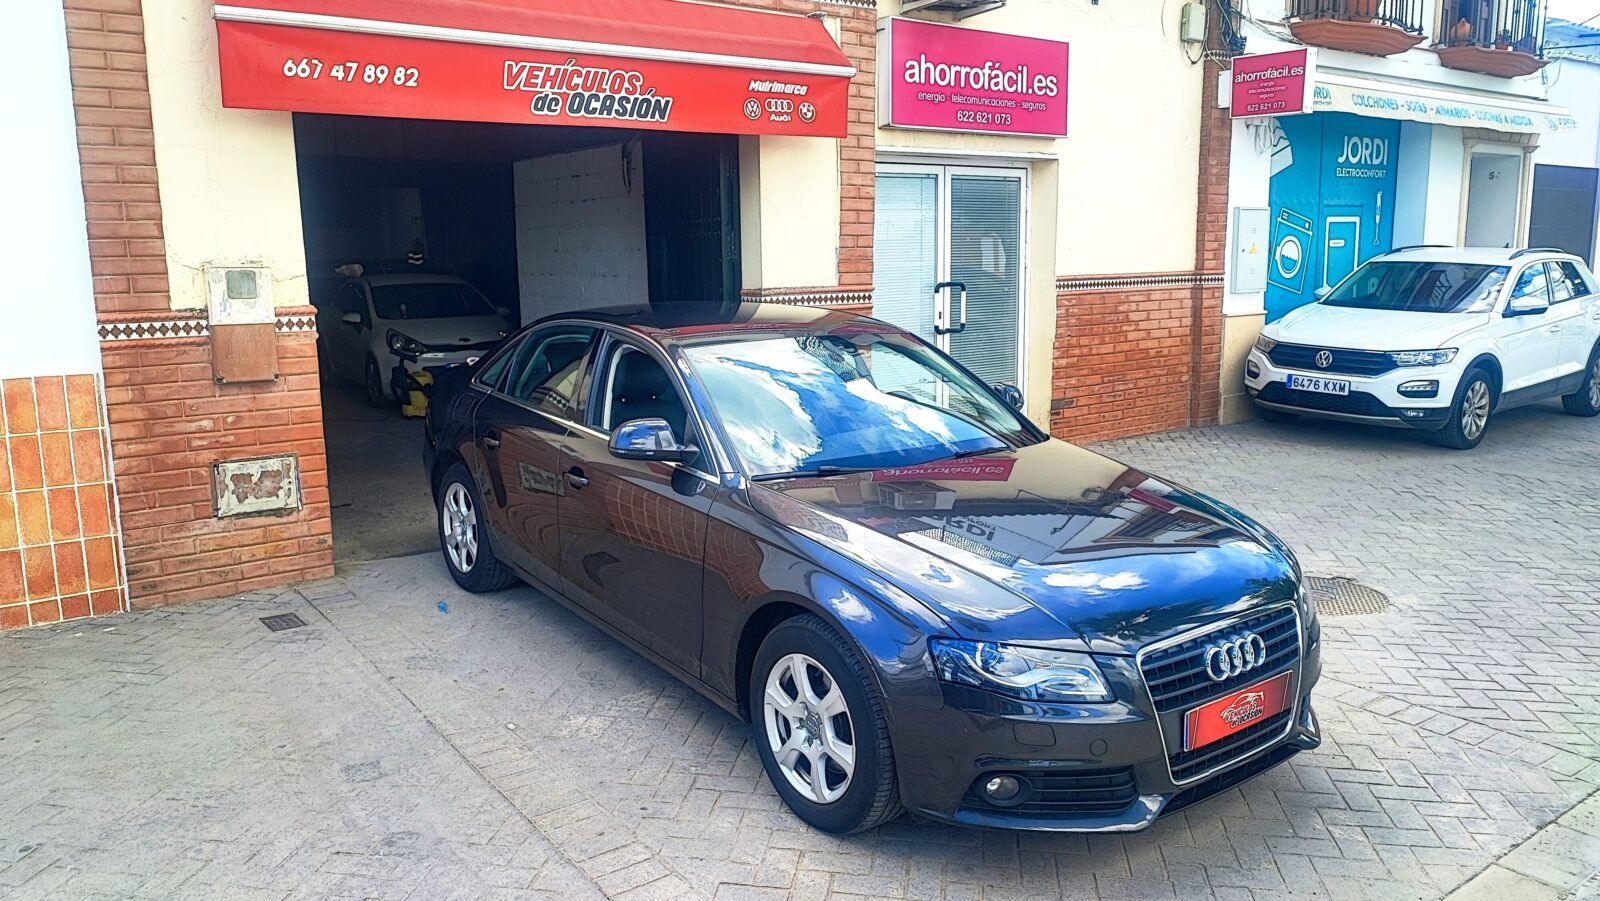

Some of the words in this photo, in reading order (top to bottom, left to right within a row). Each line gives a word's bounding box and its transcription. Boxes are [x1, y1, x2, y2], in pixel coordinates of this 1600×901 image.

[283, 58, 324, 80] 667
[329, 62, 359, 83] 47
[362, 64, 390, 85] 89
[391, 67, 420, 88] 82
[503, 58, 645, 95] VEHÍCULOS
[904, 53, 1058, 96] ahorrofácil.es
[1234, 66, 1304, 83] ahorrofácil.es
[530, 92, 562, 116] de
[566, 88, 674, 123] OCASIÓN
[951, 93, 1016, 109] telecomunicaciones
[1021, 102, 1046, 112] seguros
[1247, 104, 1259, 112] 622
[1273, 101, 1286, 109] 073
[1352, 93, 1399, 110] COLCHONES
[769, 114, 791, 122] Audi
[957, 111, 974, 123] 622
[976, 112, 992, 124] 621
[994, 113, 1011, 125] 073
[1337, 135, 1388, 165] JORDI
[1336, 168, 1386, 178] ELECTROCONFORT
[1293, 377, 1320, 390] 6476
[1324, 380, 1346, 393] KXM
